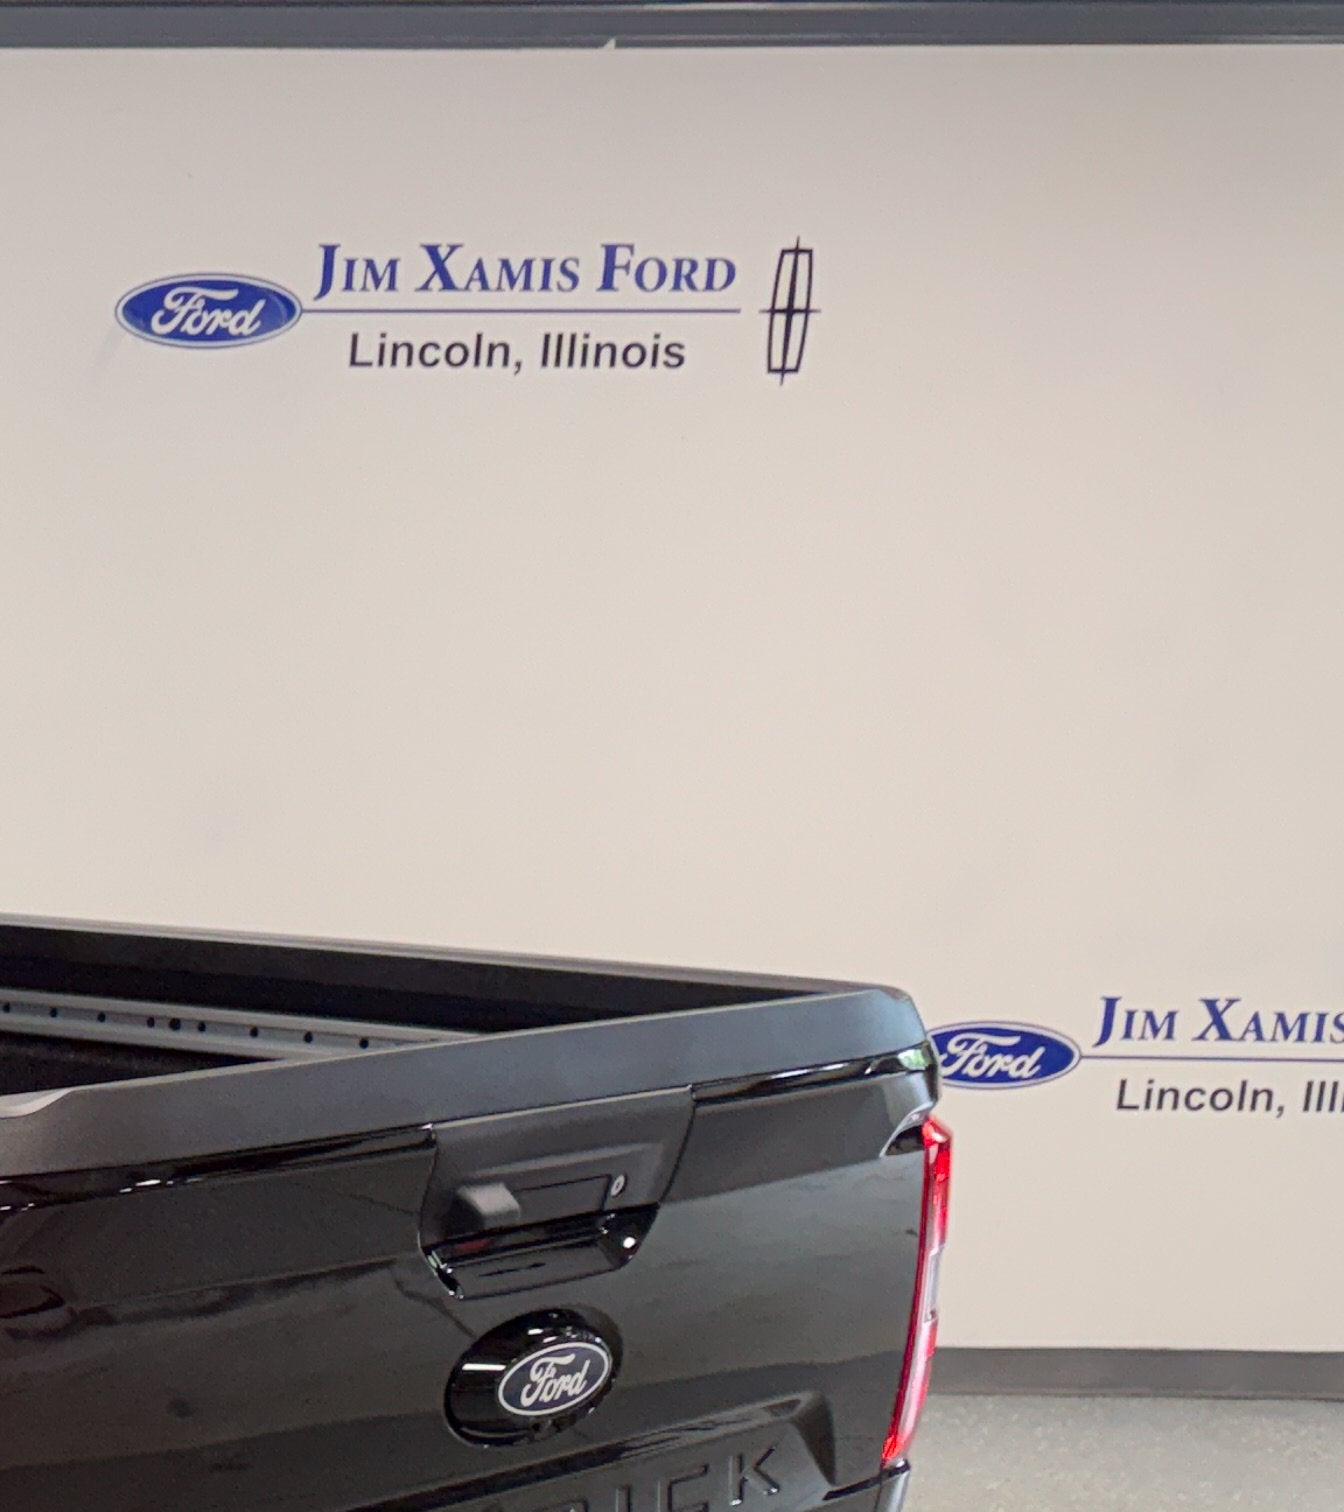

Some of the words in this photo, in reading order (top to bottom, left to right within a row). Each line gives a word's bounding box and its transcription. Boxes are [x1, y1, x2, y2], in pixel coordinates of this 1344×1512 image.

[313, 243, 401, 301] JIM
[414, 244, 580, 293] XAMIS
[596, 244, 737, 293] FORD
[150, 286, 267, 336] Ford
[349, 332, 523, 375] Lincoln,
[540, 332, 686, 369] Illinois
[1092, 996, 1179, 1048] JIM
[938, 1031, 1046, 1080] Ford
[1116, 1078, 1285, 1119] Lincoln,
[520, 1353, 591, 1407] Ford
